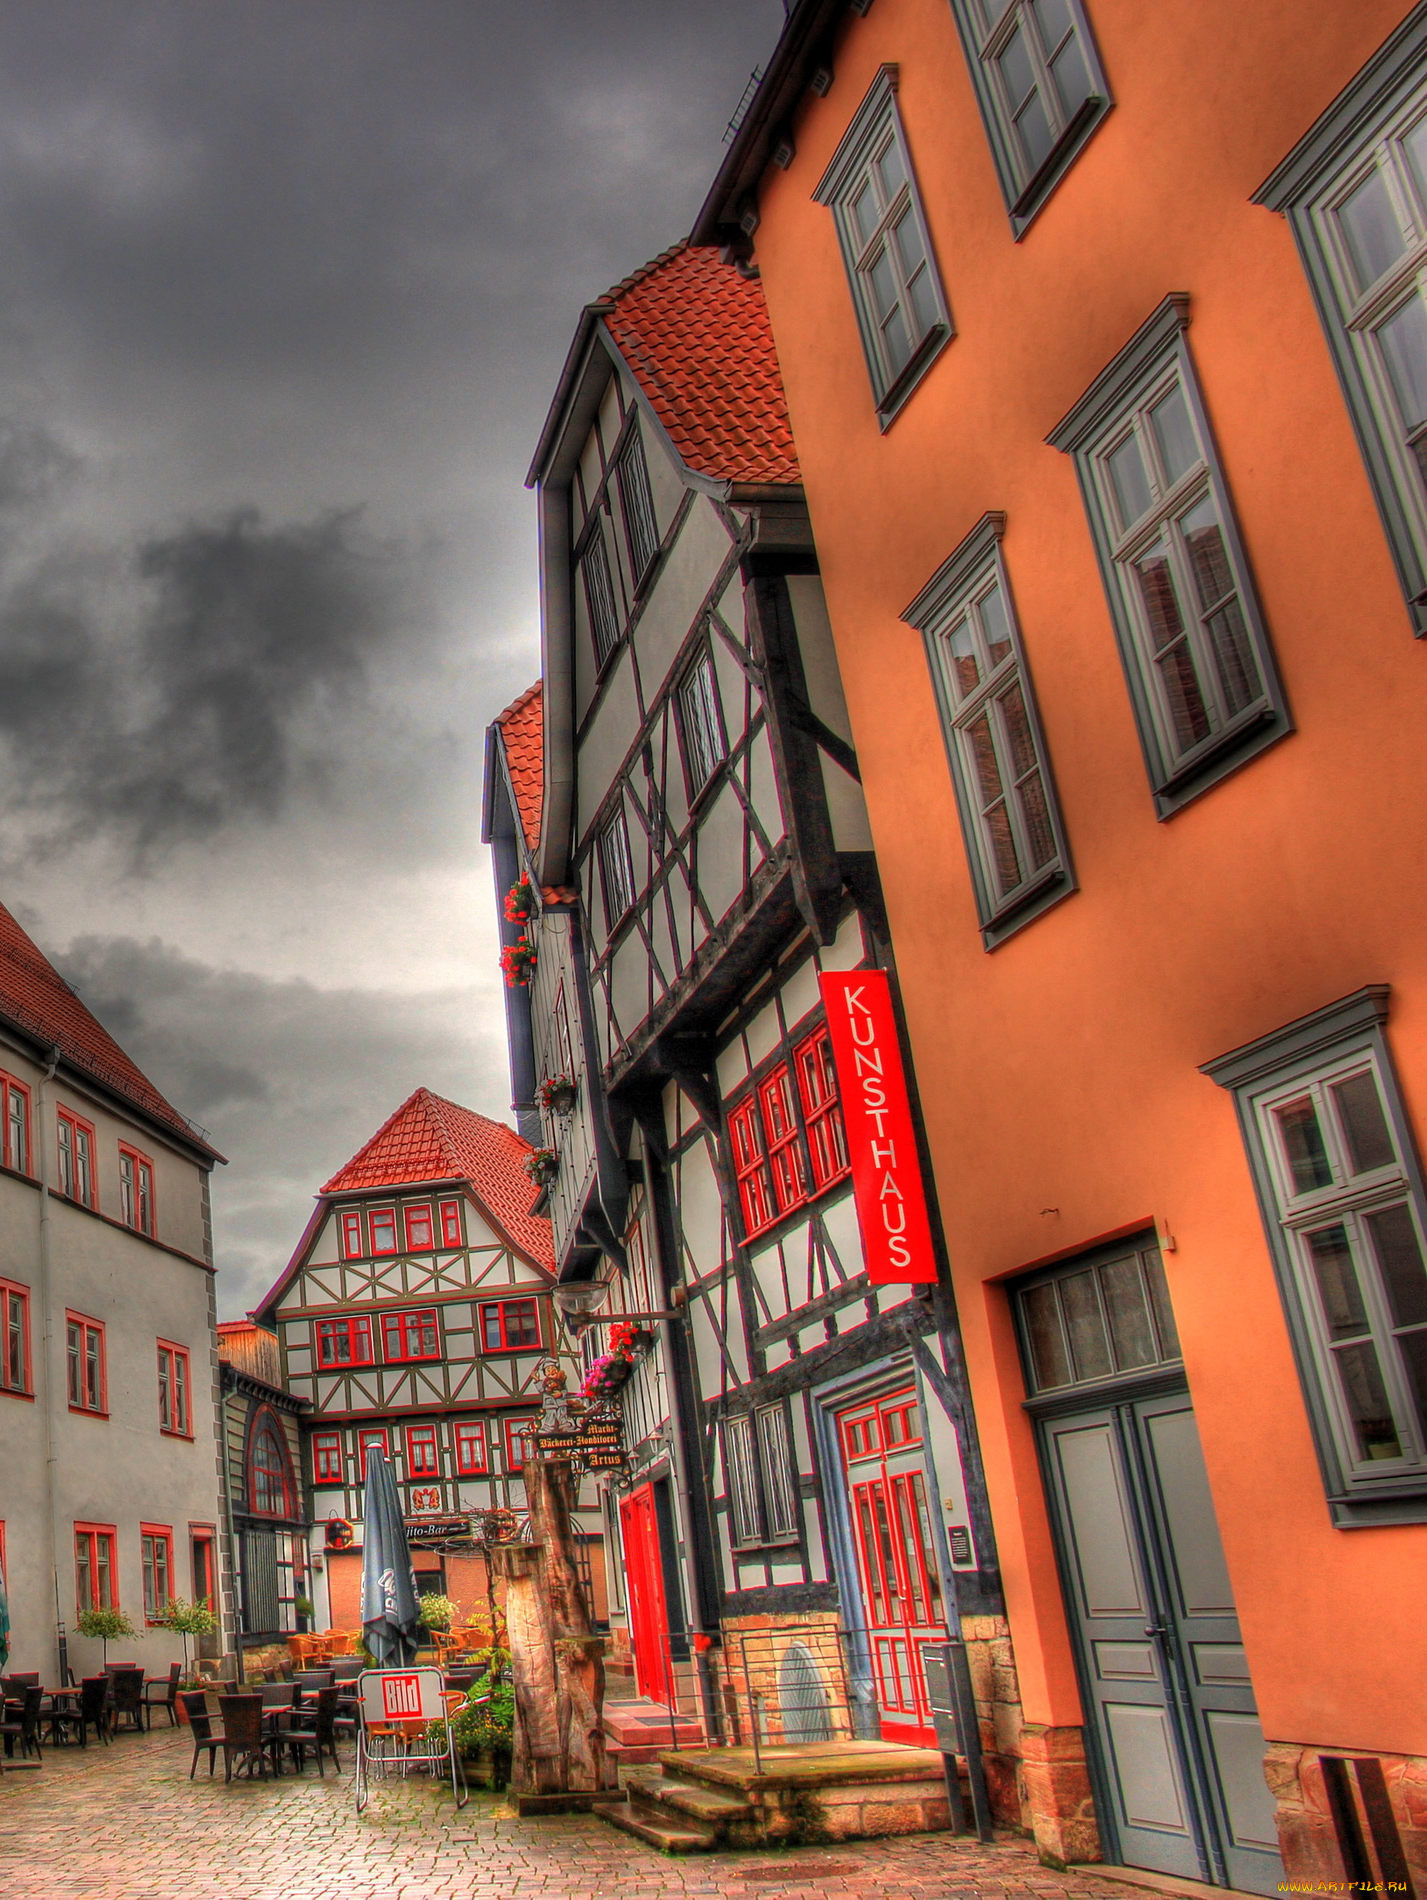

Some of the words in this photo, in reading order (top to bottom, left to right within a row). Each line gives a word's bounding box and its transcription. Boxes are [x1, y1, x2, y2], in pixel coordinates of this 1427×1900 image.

[843, 985, 912, 1268] KUNSTHAUS
[589, 1453, 622, 1467] Artus
[406, 1524, 447, 1538] jito-Bar
[384, 1679, 420, 1714] Bild
